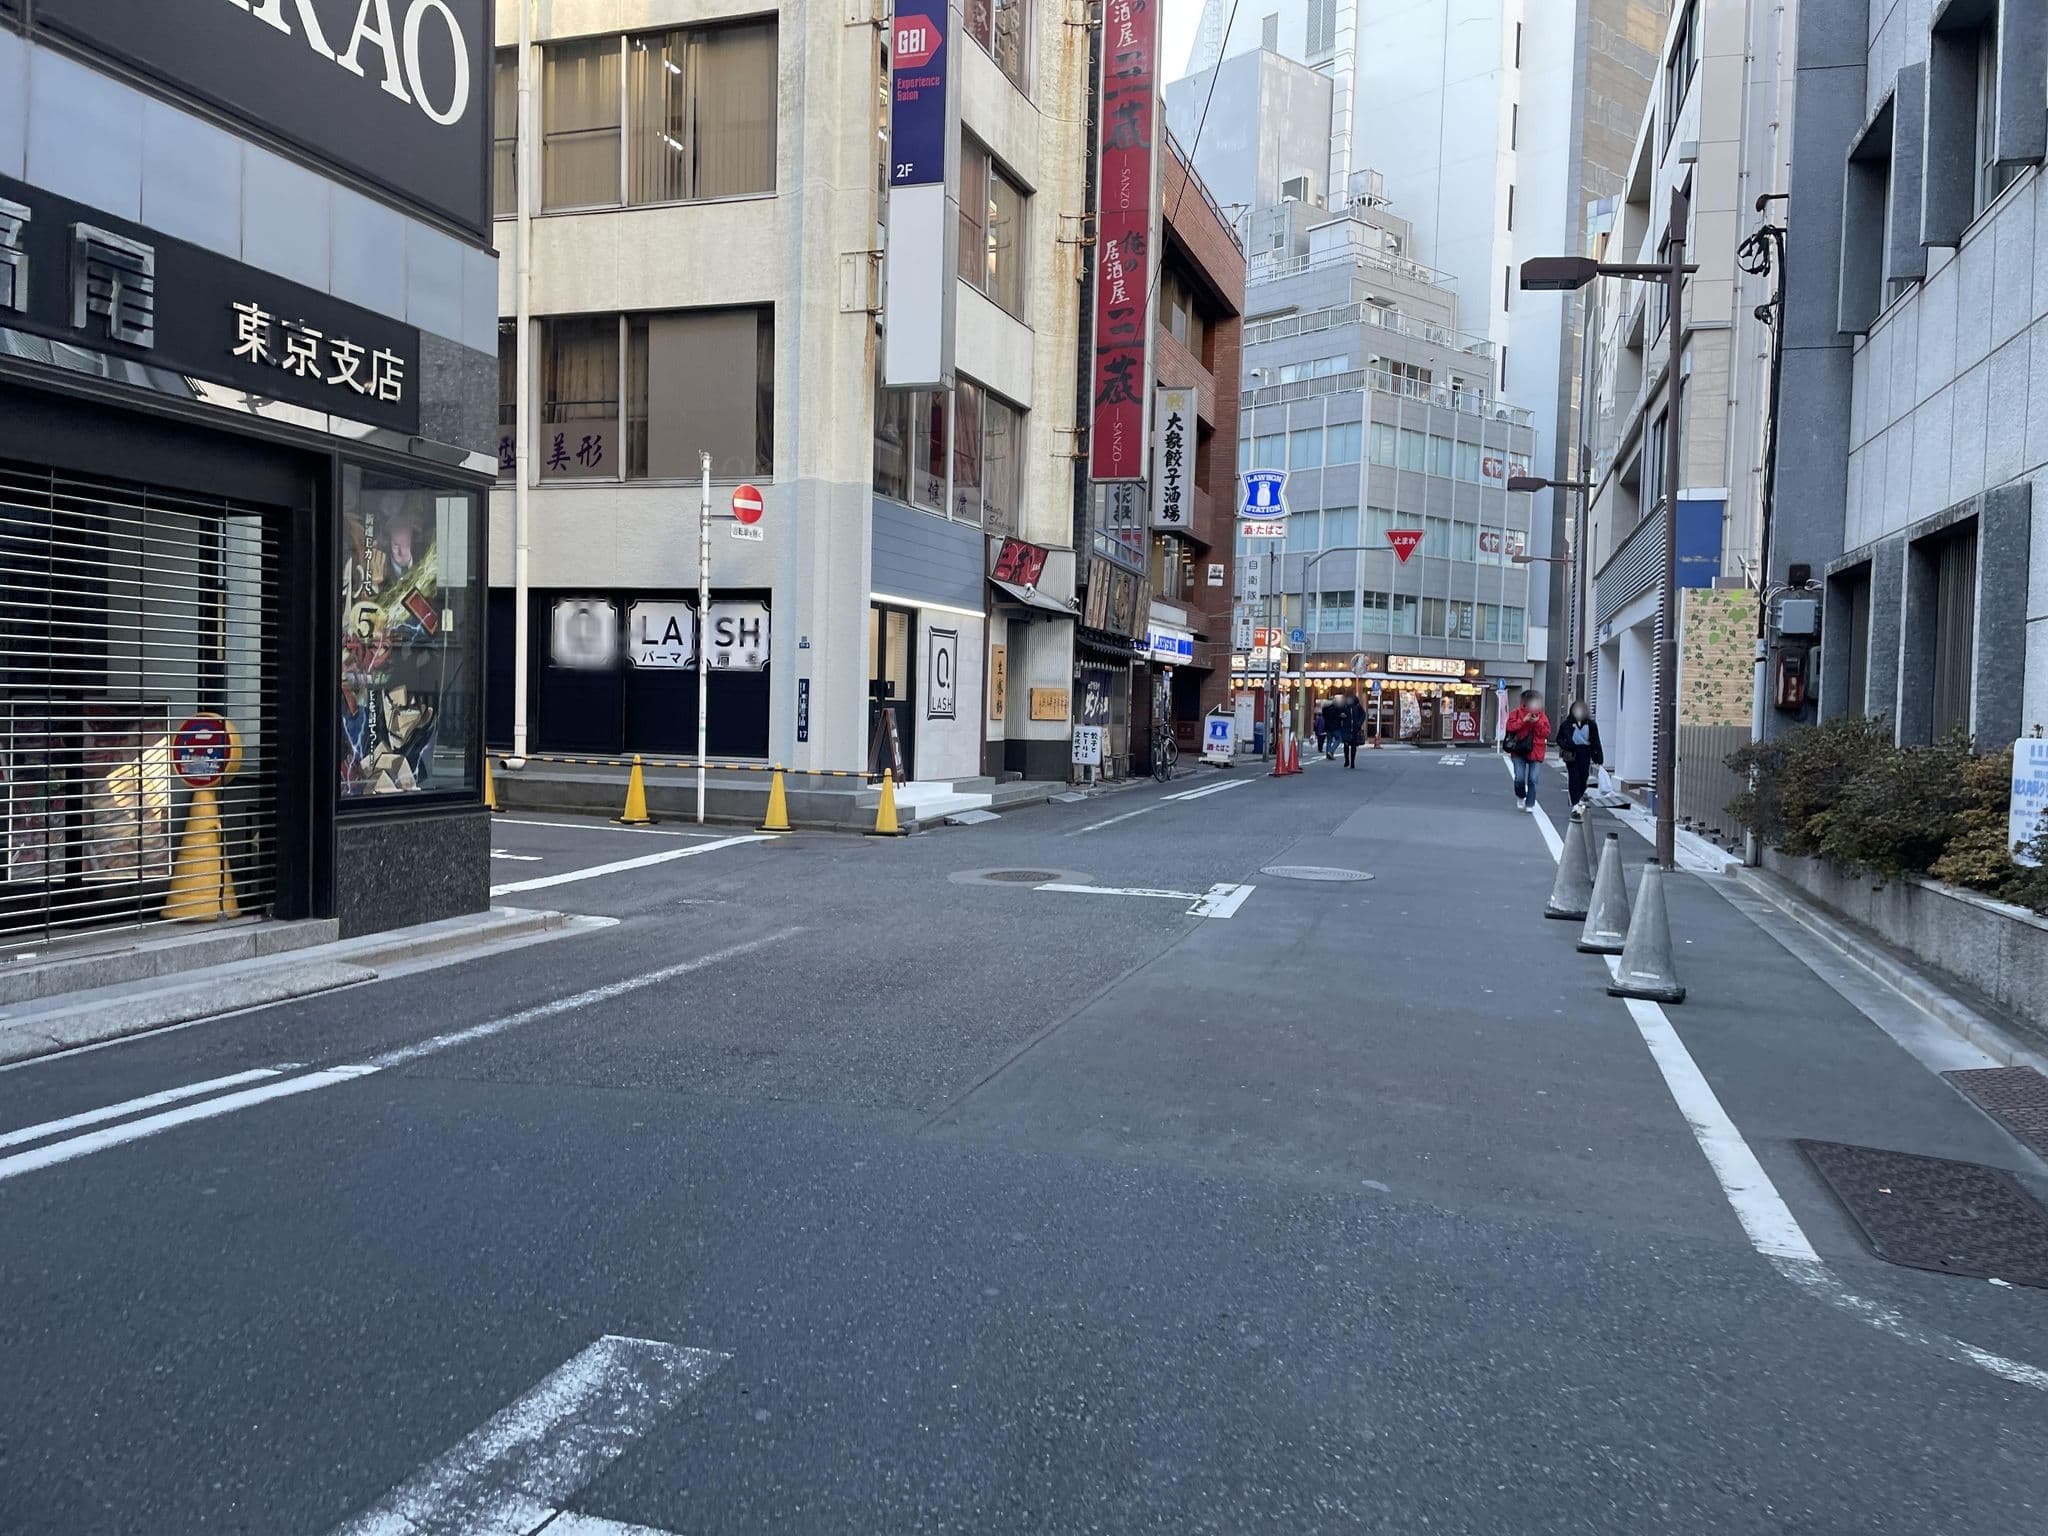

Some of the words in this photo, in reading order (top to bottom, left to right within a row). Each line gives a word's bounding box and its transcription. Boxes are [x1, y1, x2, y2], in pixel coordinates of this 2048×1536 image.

[898, 29, 926, 54] GBI
[897, 76, 940, 90] Experience
[897, 90, 919, 101] Salon
[897, 164, 913, 178] 2F
[1102, 239, 1130, 305] 居酒屋
[232, 301, 405, 403] 東京支店
[546, 432, 603, 471] 美形
[1163, 411, 1184, 523] 大衆餃子酒場
[1247, 474, 1282, 483] LAWSON
[1245, 504, 1282, 514] STATION
[1394, 536, 1416, 545] 止まれ
[1247, 560, 1257, 601] 自衛隊
[359, 608, 378, 638] 5
[932, 697, 952, 711] LASH
